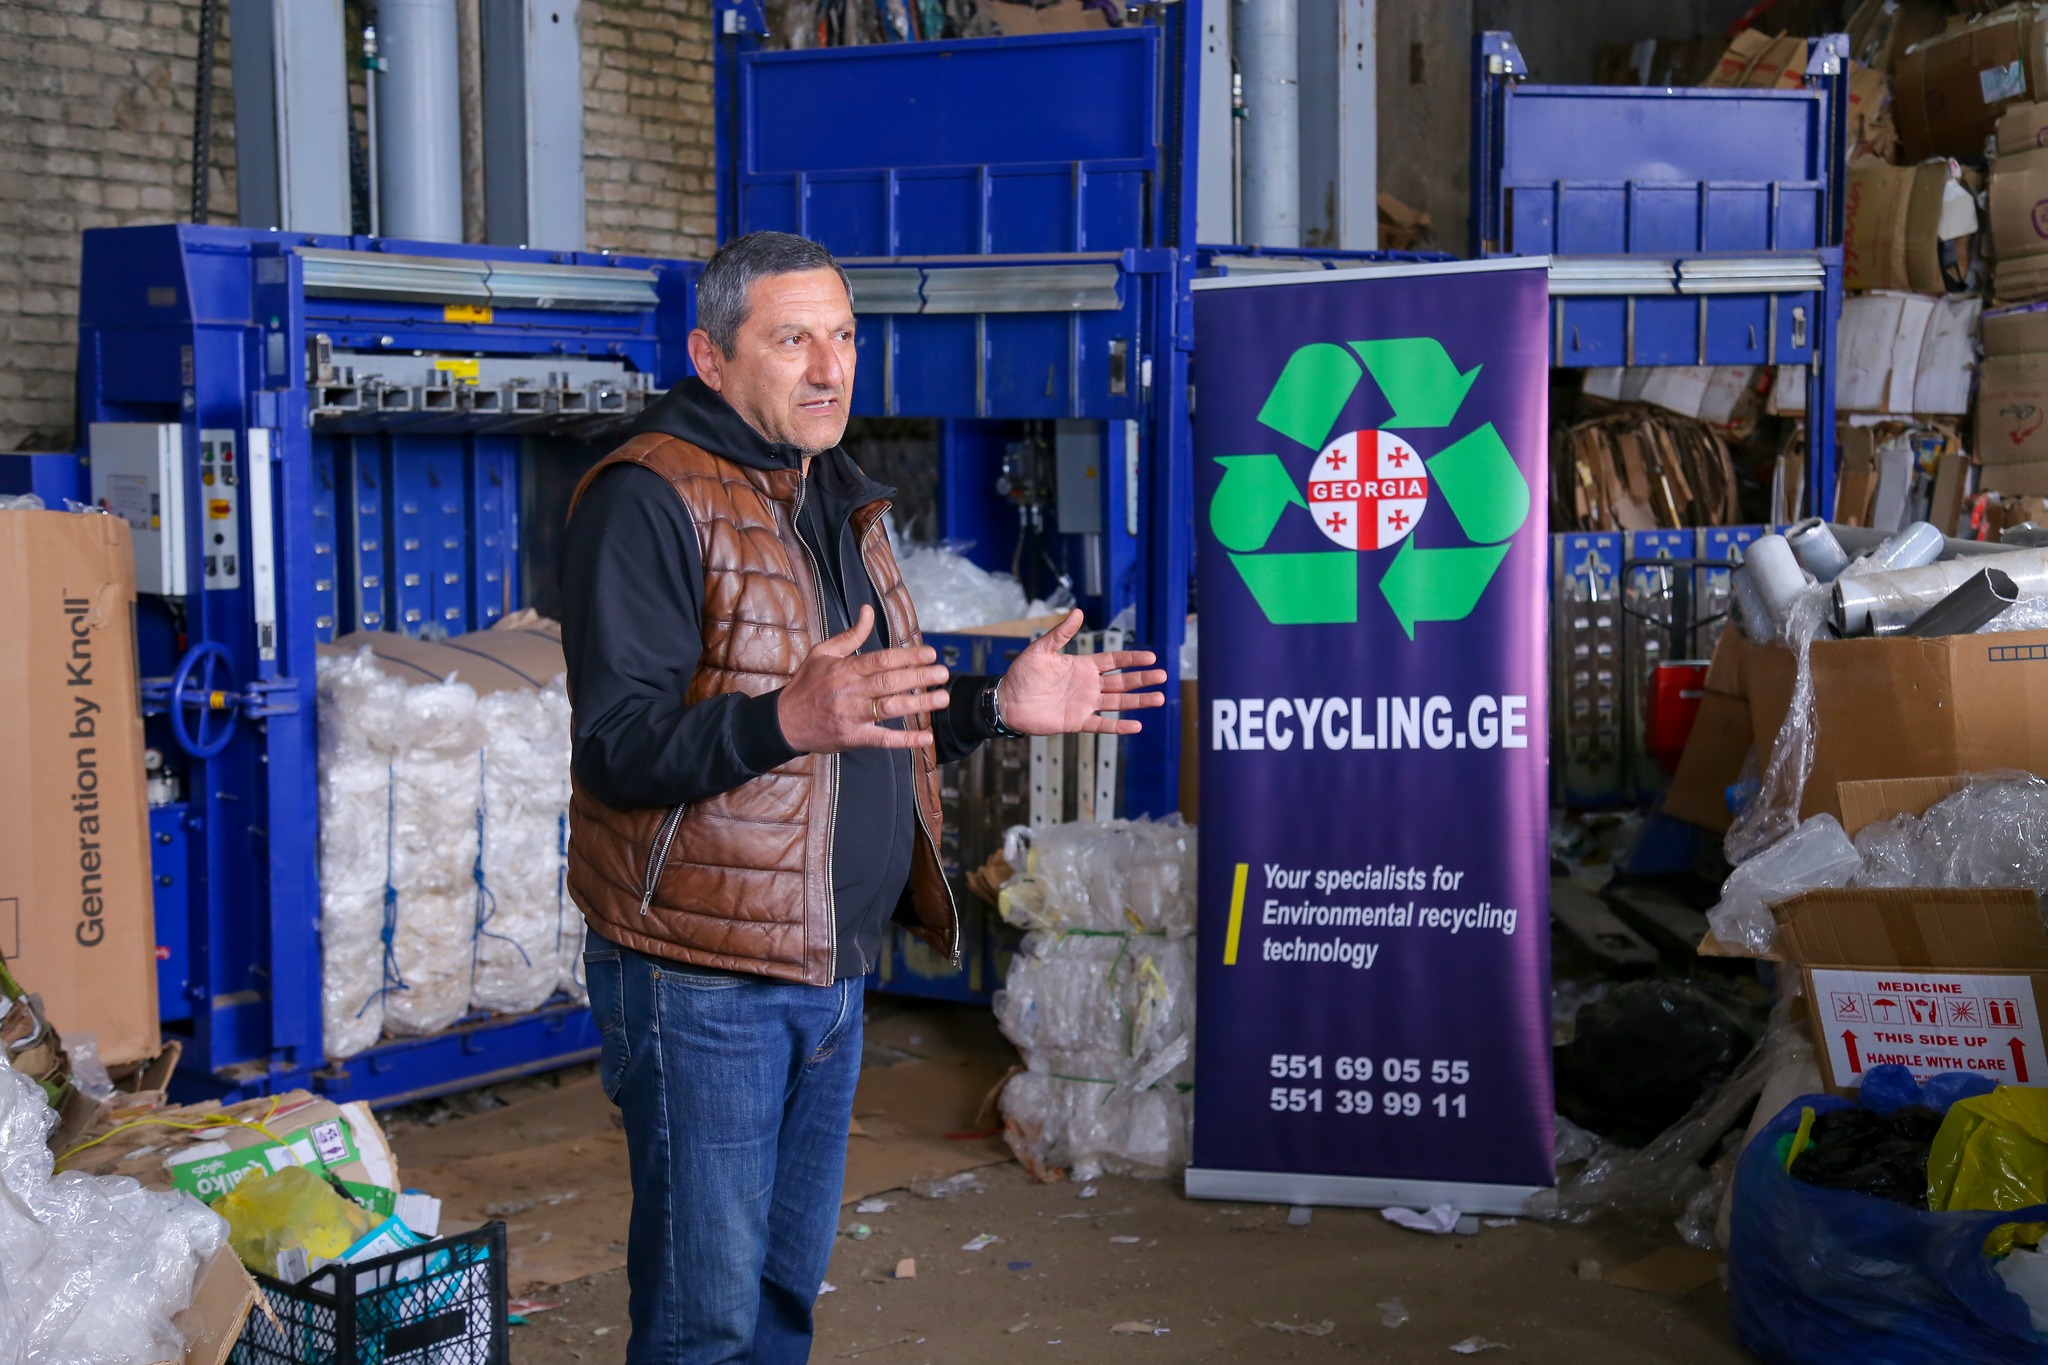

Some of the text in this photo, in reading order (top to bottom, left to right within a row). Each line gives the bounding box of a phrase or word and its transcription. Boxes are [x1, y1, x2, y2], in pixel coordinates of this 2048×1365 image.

[1313, 480, 1423, 500] GEORGIA
[69, 697, 101, 739] by
[1212, 695, 1528, 750] RECYCLING.GE
[71, 747, 105, 948] Generation
[1263, 863, 1465, 896] Your specialists for
[1262, 899, 1518, 936] Environmental recycling
[1262, 935, 1380, 970] technology
[1877, 981, 1963, 994] MEDICINE
[1873, 1032, 1988, 1048] THIS SIDE UP
[1270, 1054, 1470, 1084] 551 69 05 55
[1866, 1053, 2007, 1071] HANDLE WITH CARE
[1270, 1087, 1467, 1118] 551 39 99 11
